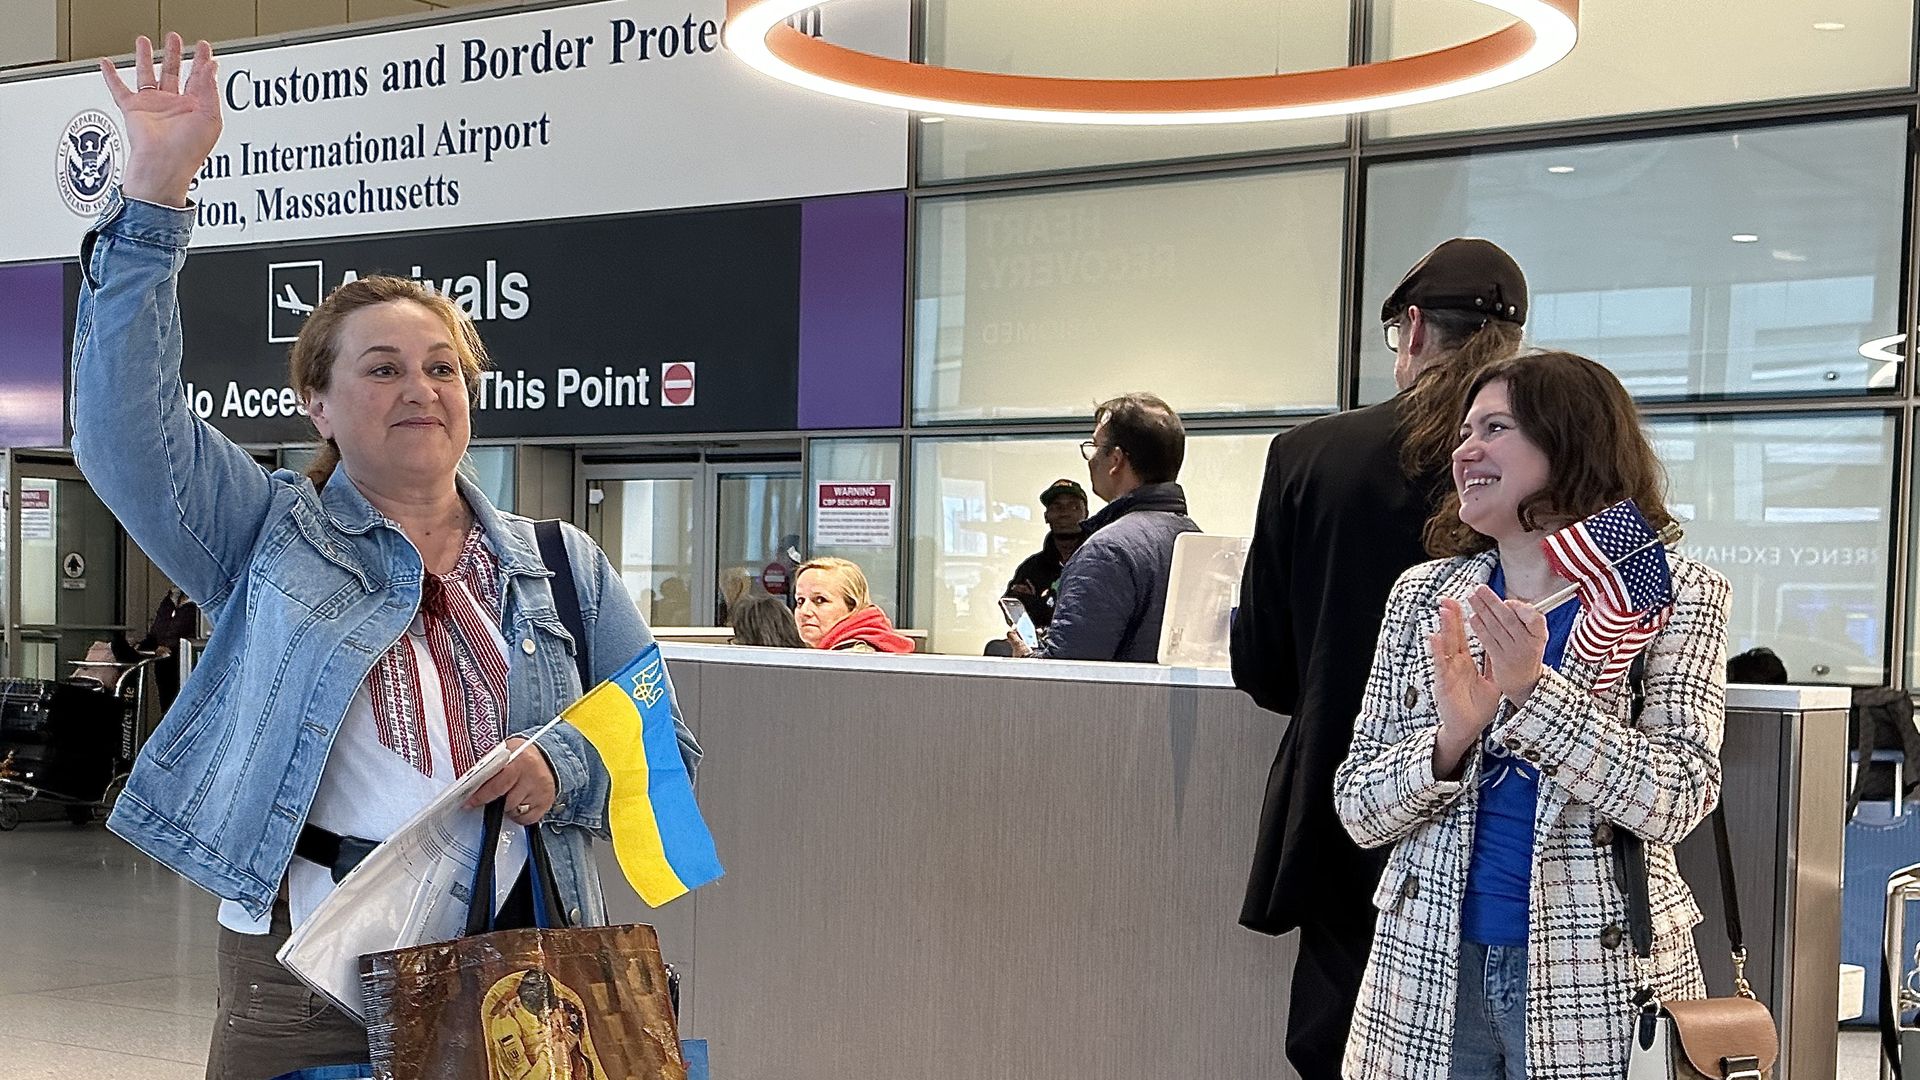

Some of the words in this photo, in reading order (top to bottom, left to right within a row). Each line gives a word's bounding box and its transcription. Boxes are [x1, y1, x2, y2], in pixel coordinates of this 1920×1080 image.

[226, 66, 367, 111] Customs
[382, 44, 446, 93] and
[461, 29, 594, 84] Border
[240, 124, 425, 176] International
[434, 112, 550, 162] Airport
[59, 172, 91, 212] HOMELAND
[197, 198, 246, 232] ton,
[256, 175, 459, 222] Massachusetts
[479, 370, 546, 410] This
[557, 366, 650, 408] Point
[833, 487, 876, 496] WARNING
